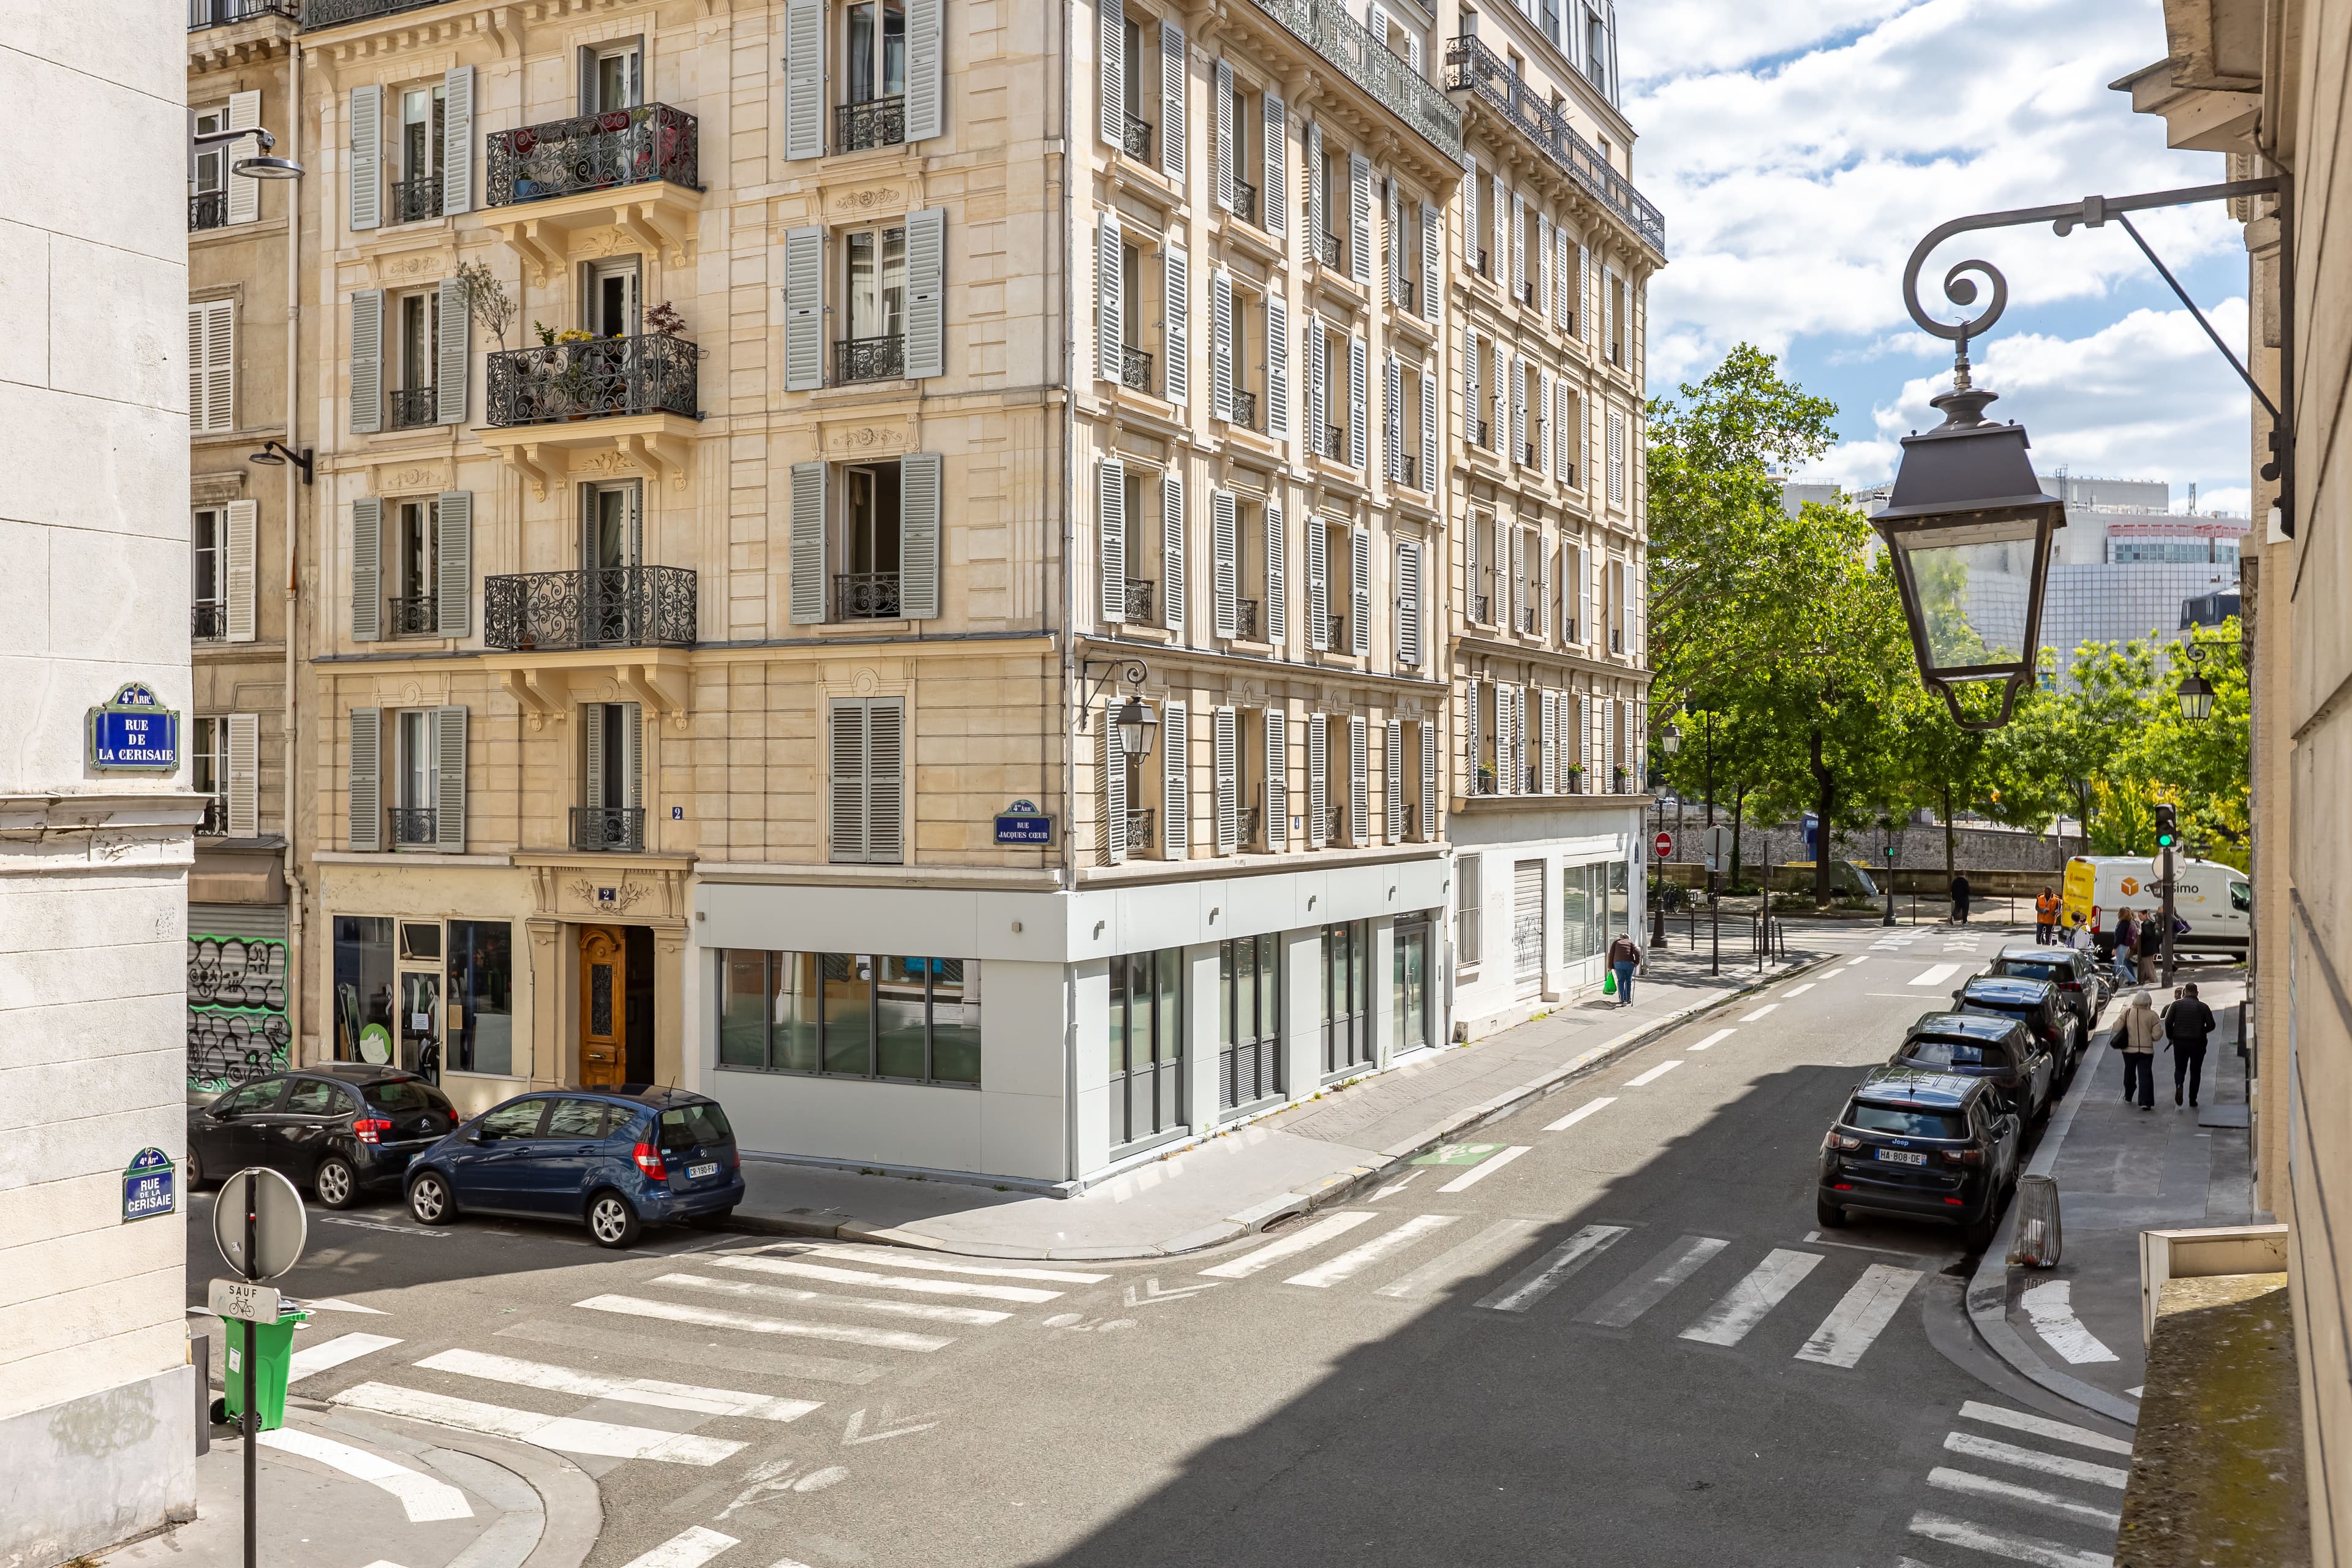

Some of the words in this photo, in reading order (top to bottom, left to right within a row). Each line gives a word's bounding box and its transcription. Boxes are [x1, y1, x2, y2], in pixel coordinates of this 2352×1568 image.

[125, 720, 149, 731] RUE
[128, 734, 145, 745] DE
[99, 749, 115, 760] LA
[118, 749, 173, 761] CERISAIE
[675, 807, 681, 820] 2
[2144, 883, 2199, 893] csimo
[603, 889, 610, 900] 2
[140, 1157, 147, 1166] 4e
[1880, 1150, 1921, 1164] HA-808-DE
[690, 1165, 715, 1176] CR-190-FA
[140, 1177, 160, 1191] RUE
[128, 1193, 171, 1213] CERISAIE
[229, 1285, 257, 1298] SAUF
